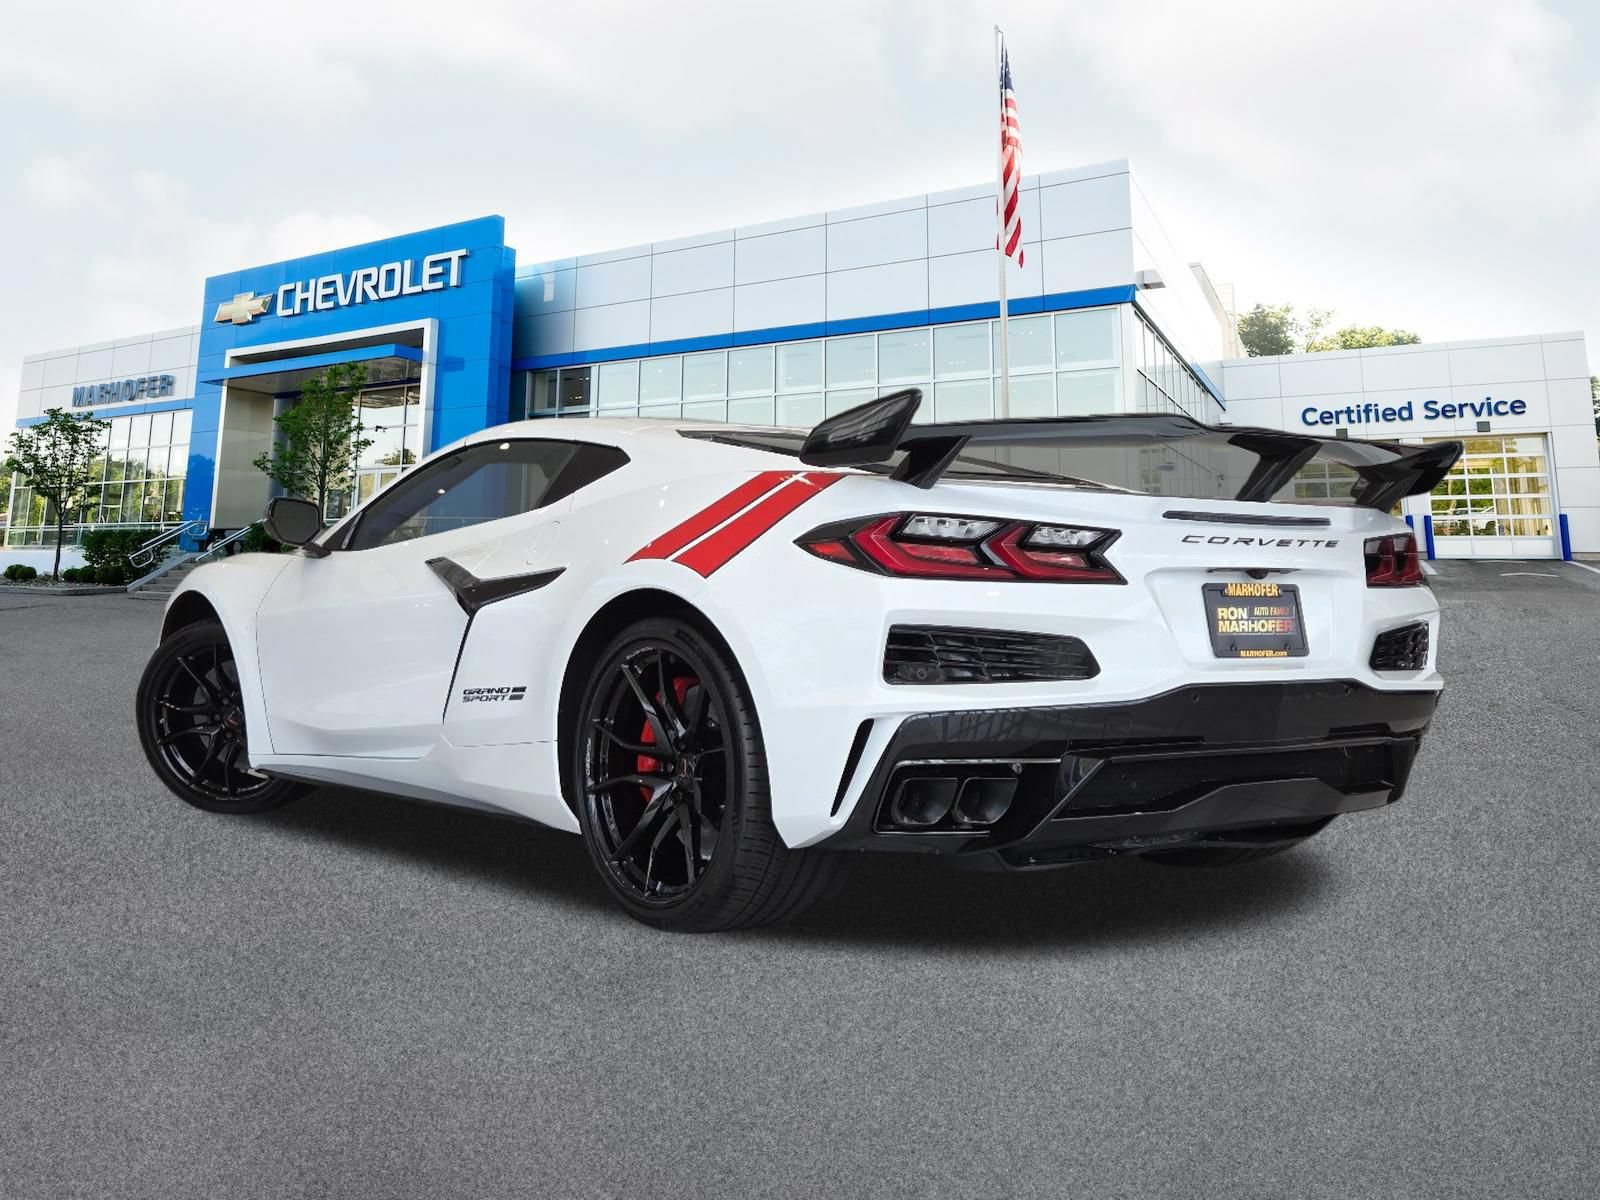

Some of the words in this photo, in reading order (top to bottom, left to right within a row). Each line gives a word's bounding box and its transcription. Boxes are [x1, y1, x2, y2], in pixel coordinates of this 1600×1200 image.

[276, 248, 469, 317] CHEVROLET
[72, 374, 176, 407] MARHOFER
[1301, 401, 1413, 426] Certified
[1423, 396, 1527, 420] Service
[1181, 535, 1340, 548] CORVETTE
[1227, 583, 1279, 597] MARHOFER
[1217, 607, 1248, 619] RON
[1254, 606, 1269, 616] AUTO
[1270, 606, 1289, 616] FAM
[1218, 620, 1294, 632] MARHOFER
[463, 687, 511, 695] GRAND
[462, 694, 508, 703] SPORT
